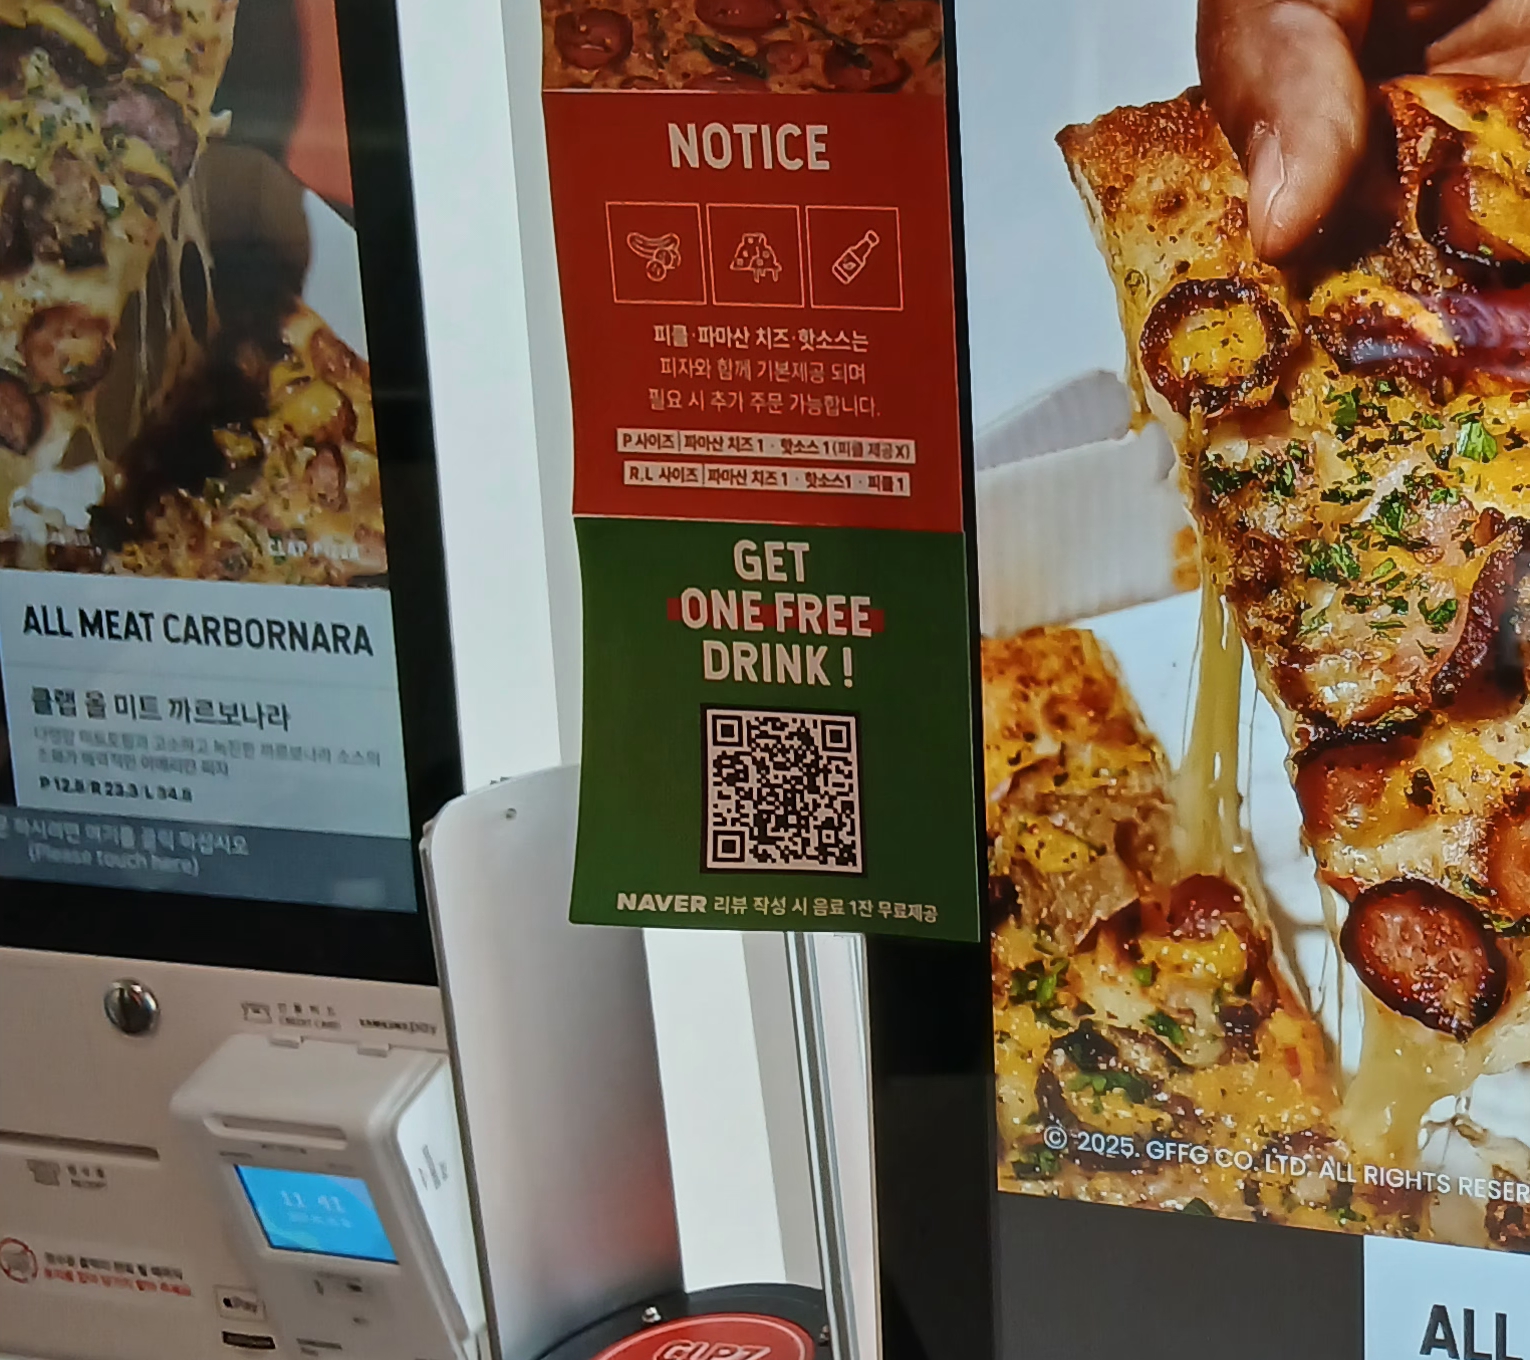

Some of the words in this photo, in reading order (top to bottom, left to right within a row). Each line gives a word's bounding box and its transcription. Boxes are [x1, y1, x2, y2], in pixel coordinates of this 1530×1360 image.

[667, 121, 831, 171] NOTICE
[660, 357, 712, 380] 피자와
[716, 358, 751, 382] 함께
[831, 362, 867, 385] 되며
[649, 388, 683, 411] 필요
[688, 390, 705, 412] 시
[710, 391, 744, 413] 추가
[750, 392, 784, 415] 주문
[789, 393, 881, 418] 가능합니다.
[622, 432, 633, 448] P
[635, 432, 676, 450] 사이즈
[658, 466, 699, 484] 사이즈
[733, 538, 810, 583] GET
[22, 605, 74, 639] ALL
[77, 607, 156, 643] MEAT
[162, 612, 375, 658] CARBORNARA
[680, 587, 764, 632] ONE
[774, 592, 872, 638] FREE
[616, 892, 708, 914] NAVER
[713, 895, 748, 916] 리뷰
[752, 896, 787, 917] 작성
[791, 896, 808, 916] 시
[812, 897, 845, 917] 음료
[877, 901, 938, 924] 무료제공
[1076, 1129, 1140, 1160] 2025.
[1145, 1140, 1209, 1167] GFFG
[1319, 1160, 1358, 1186] ALL
[1364, 1165, 1452, 1195] RIGHTS
